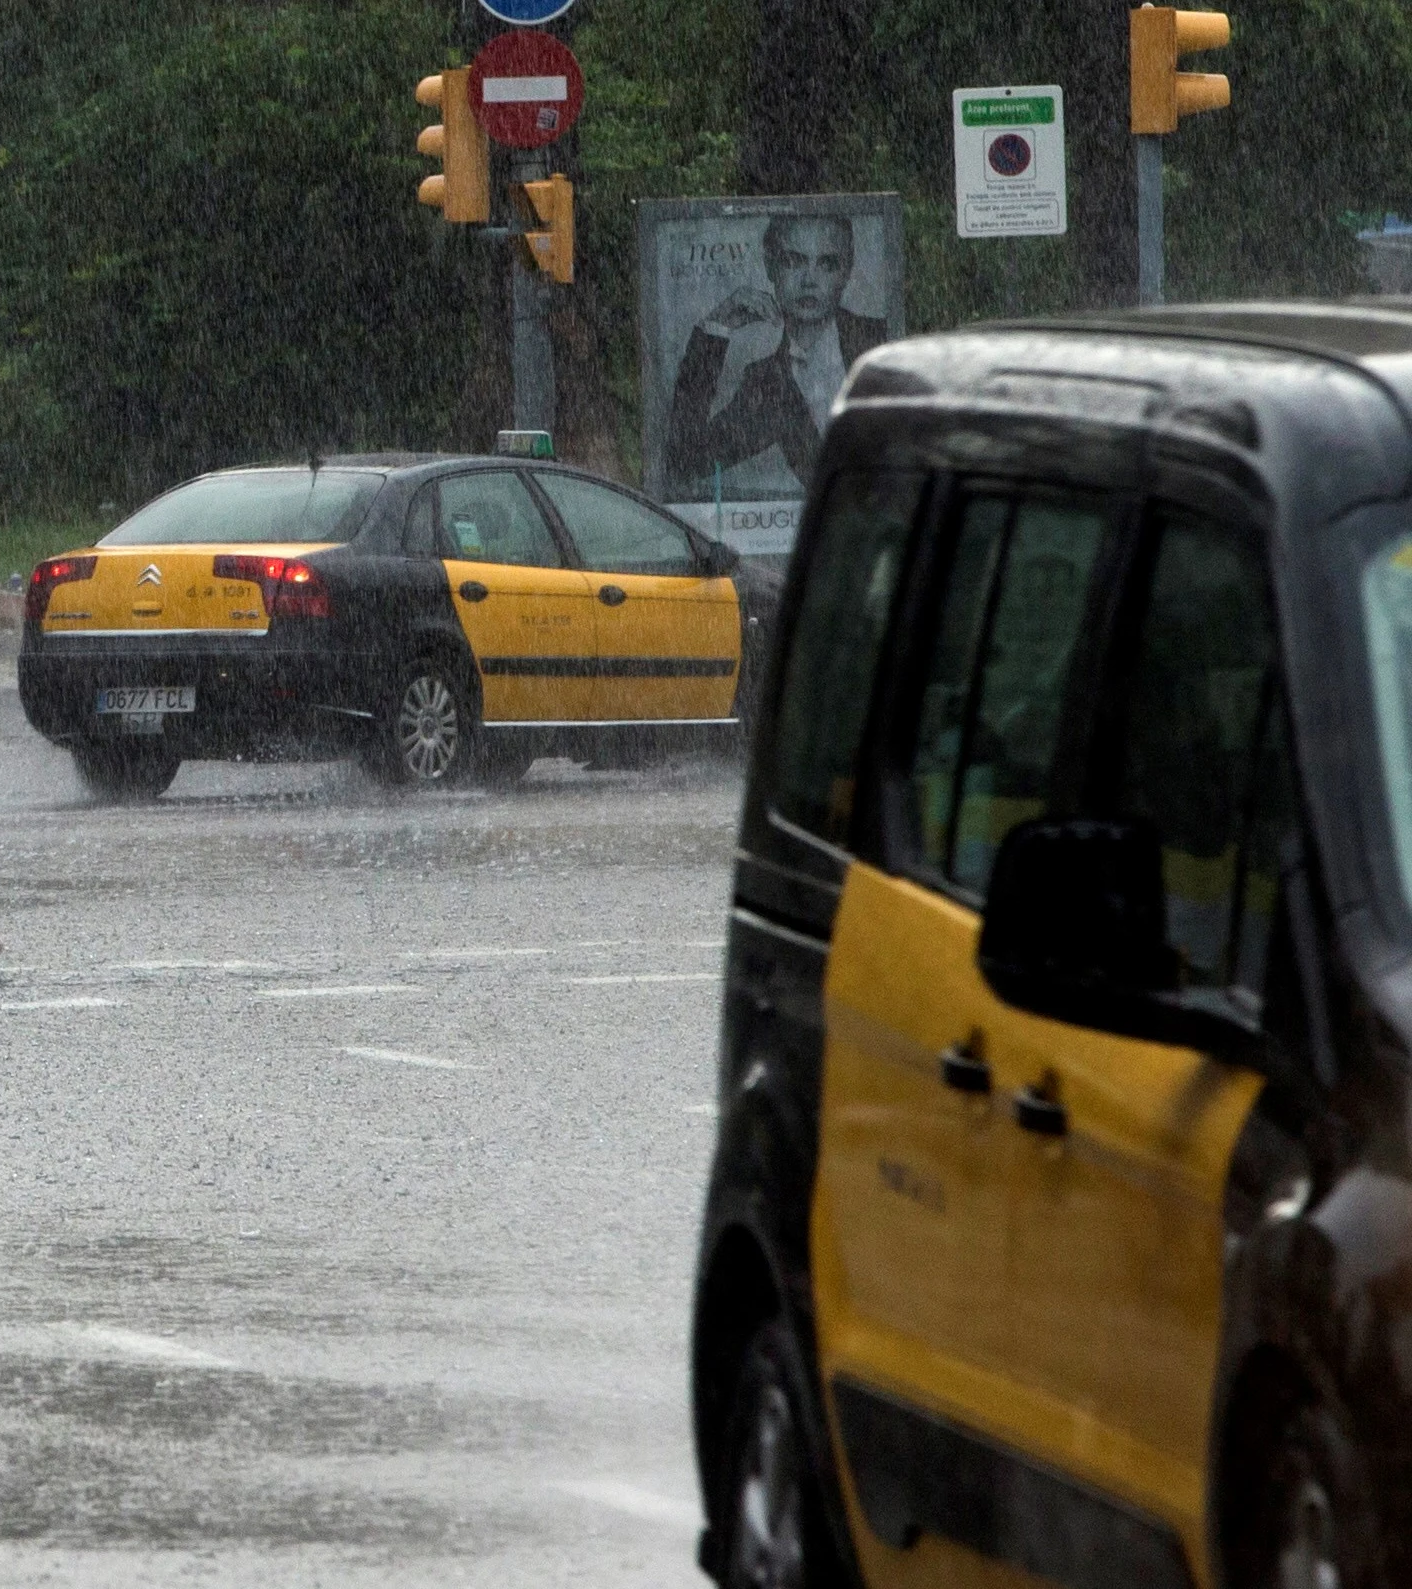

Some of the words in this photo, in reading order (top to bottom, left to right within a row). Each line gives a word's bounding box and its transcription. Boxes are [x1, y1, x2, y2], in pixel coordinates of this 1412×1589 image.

[689, 242, 750, 262] new
[731, 510, 799, 530] DOUGL
[106, 689, 149, 709] 0677
[154, 689, 188, 709] FCL
